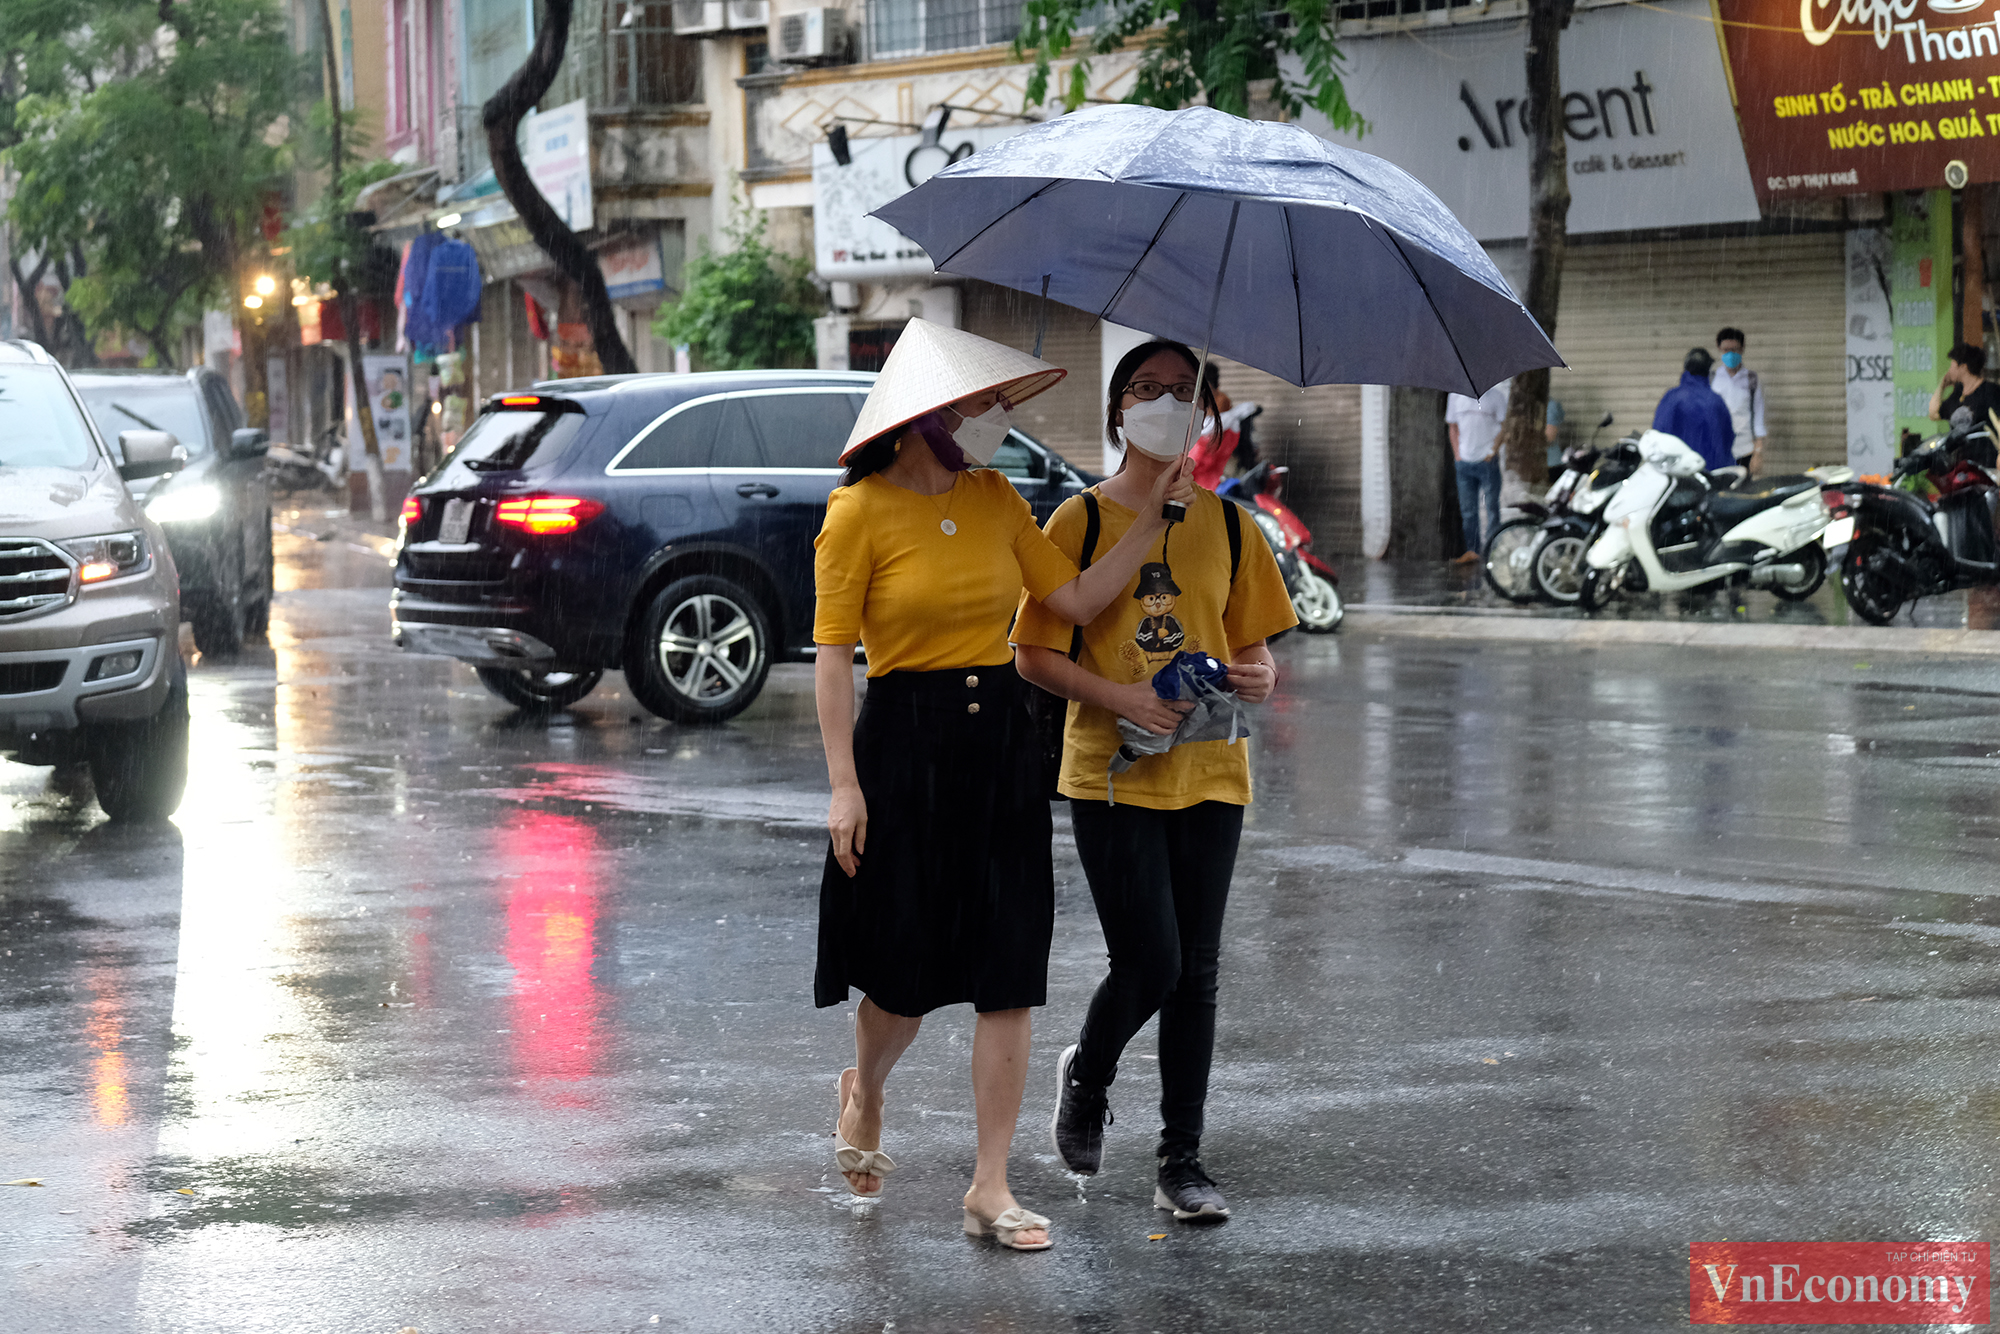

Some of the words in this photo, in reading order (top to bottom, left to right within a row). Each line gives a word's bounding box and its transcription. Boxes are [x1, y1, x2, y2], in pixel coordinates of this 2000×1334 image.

[1773, 94, 1818, 118] SINH
[1819, 82, 1847, 114] TỐ
[1859, 81, 1897, 110] TRÀ
[1900, 78, 1975, 106] CHANH
[1828, 120, 1885, 150] NƯỚC
[1889, 120, 1935, 144] HOA
[1938, 108, 1985, 140] QUẢ
